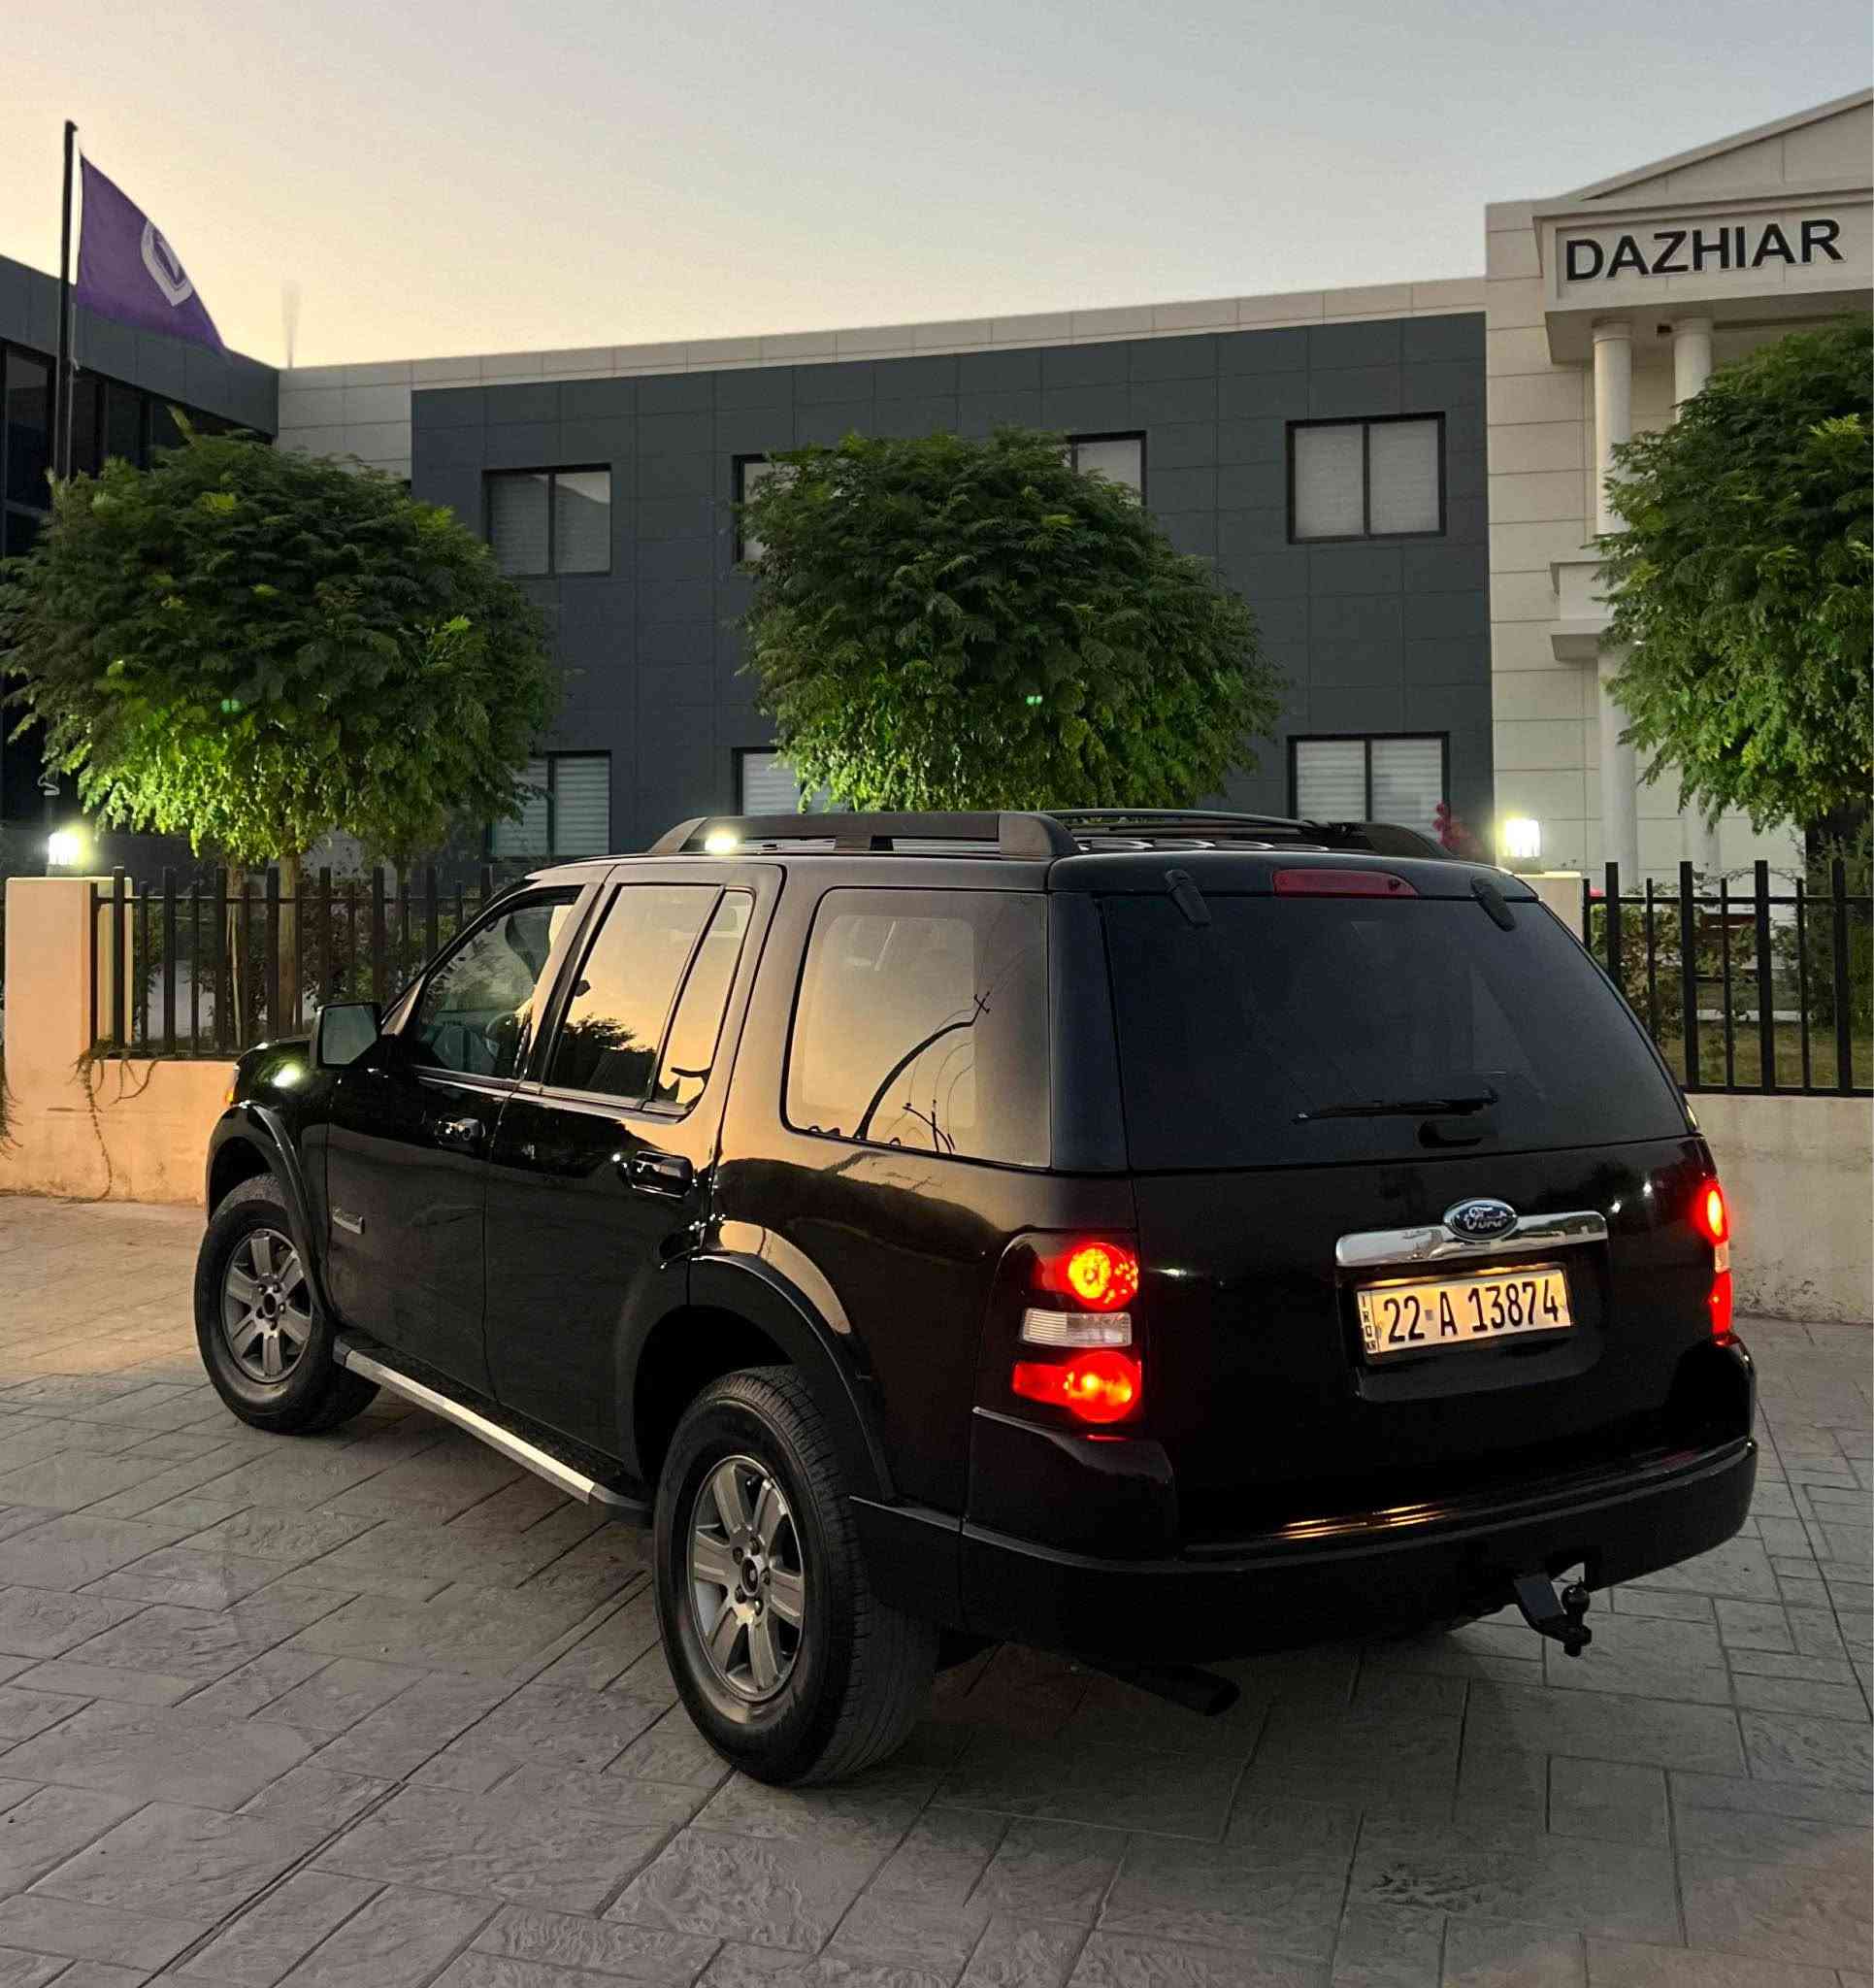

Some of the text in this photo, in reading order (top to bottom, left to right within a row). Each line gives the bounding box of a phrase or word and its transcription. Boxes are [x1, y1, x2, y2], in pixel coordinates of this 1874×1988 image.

[1565, 218, 1844, 282] DAZHIAR
[1463, 1206, 1507, 1231] Ford
[1383, 1278, 1559, 1343] 22 A 13874
